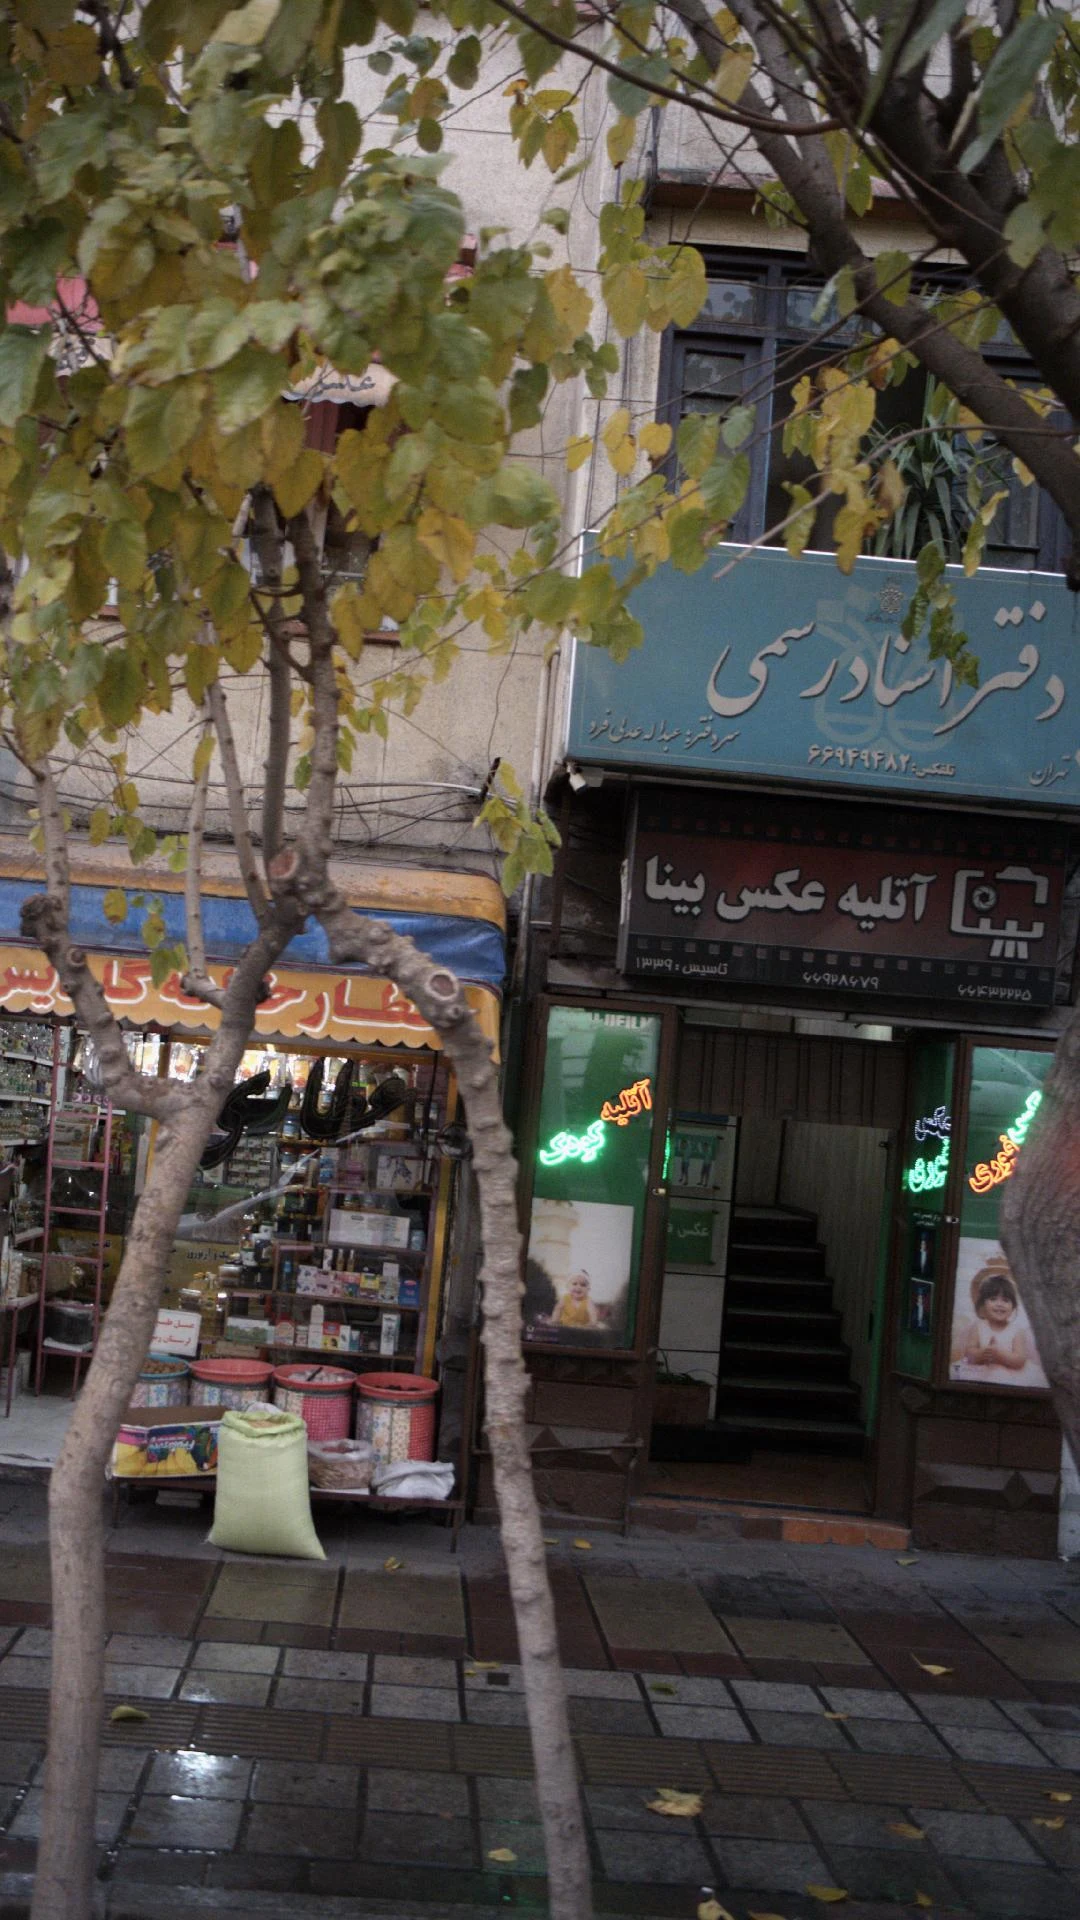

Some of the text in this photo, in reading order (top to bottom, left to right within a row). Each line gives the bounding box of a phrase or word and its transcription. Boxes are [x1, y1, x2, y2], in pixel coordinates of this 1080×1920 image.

[706, 601, 1066, 736] دفتر اسناد رسمی
[1029, 754, 1072, 787] تهران
[644, 854, 938, 932] آتلیه عکس بینا
